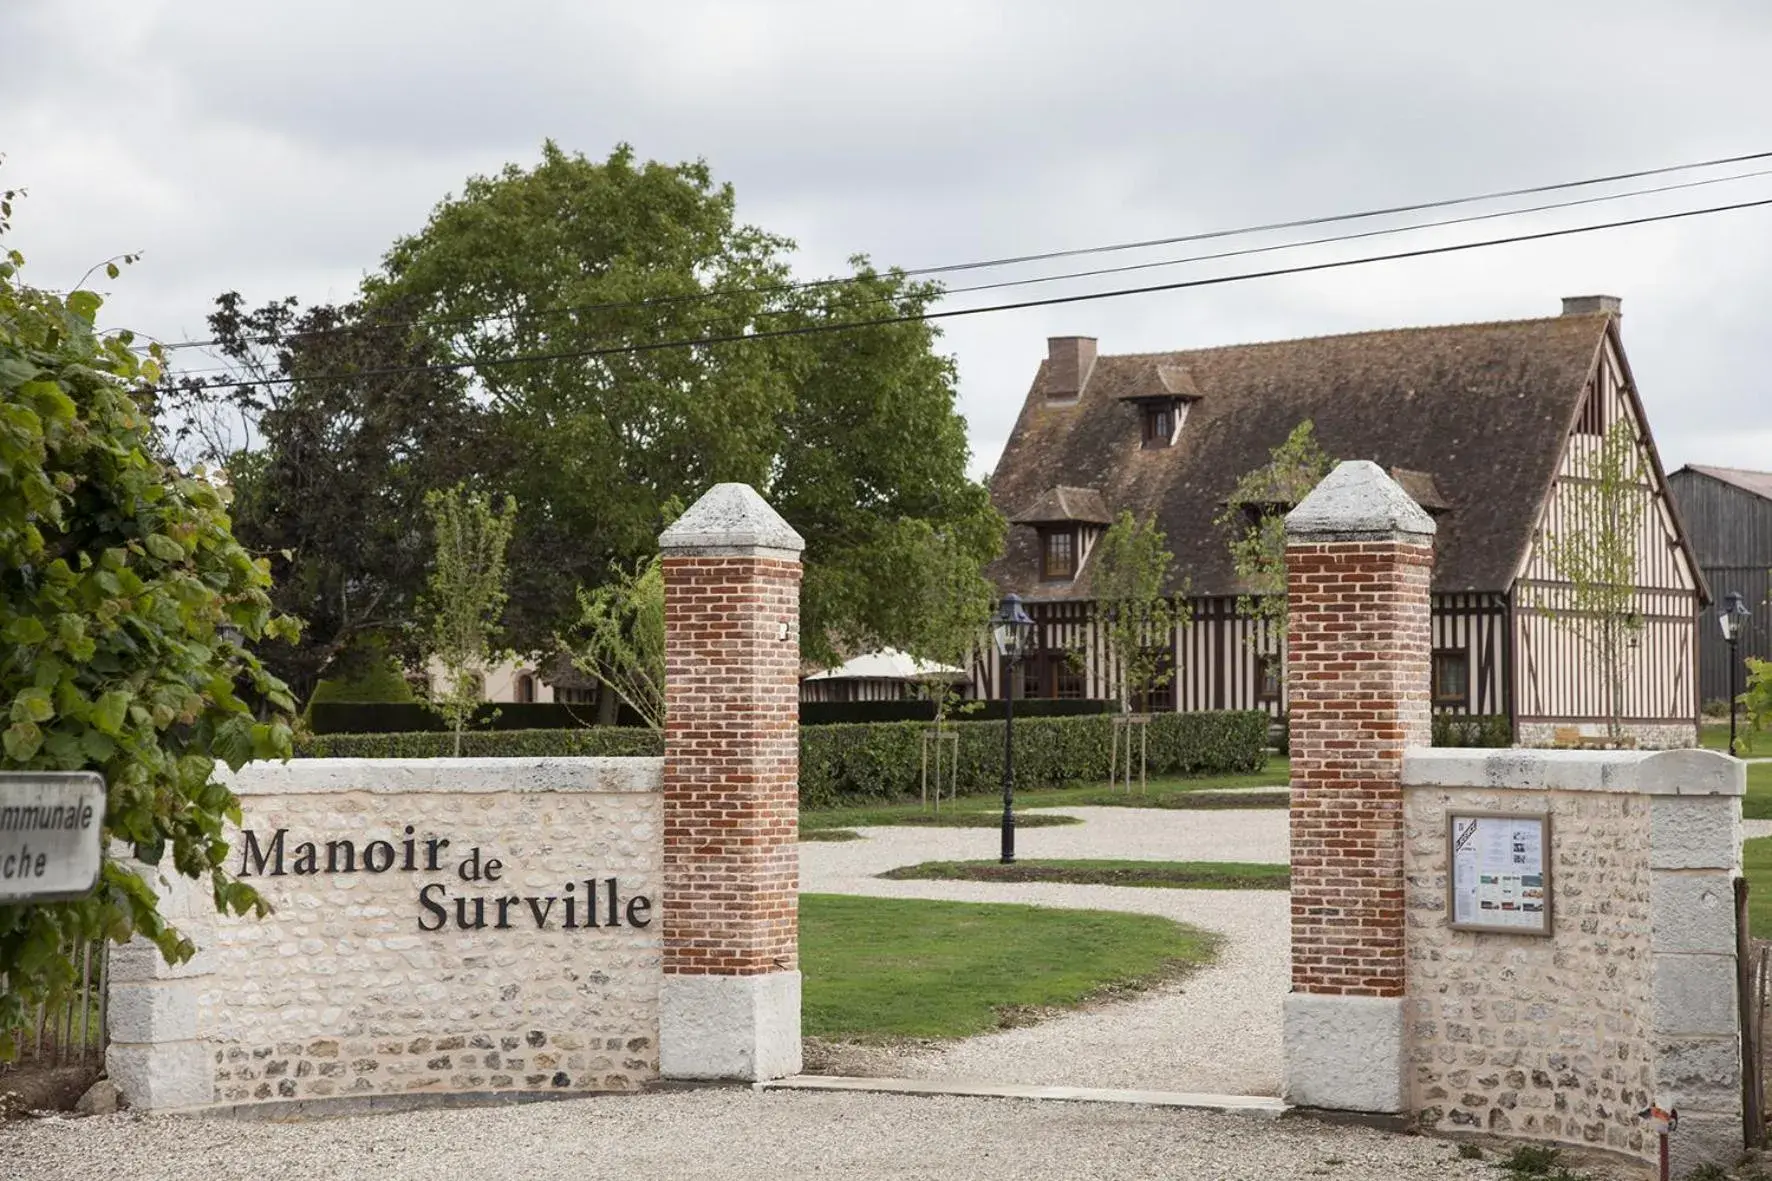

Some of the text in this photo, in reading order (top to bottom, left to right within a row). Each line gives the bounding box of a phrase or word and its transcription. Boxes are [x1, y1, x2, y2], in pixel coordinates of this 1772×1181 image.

[0, 797, 93, 831] mmunale
[0, 843, 47, 879] che
[238, 825, 502, 881] Manoir de
[418, 878, 652, 931] Surville
